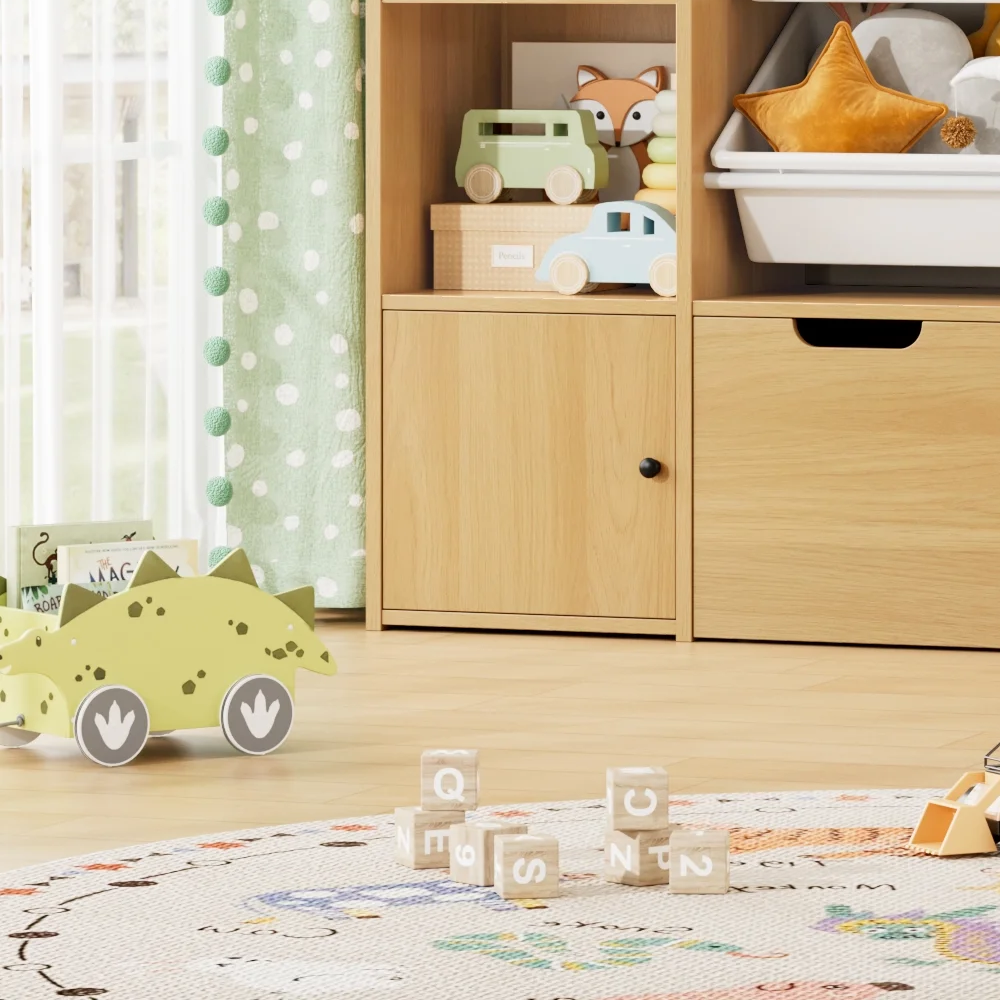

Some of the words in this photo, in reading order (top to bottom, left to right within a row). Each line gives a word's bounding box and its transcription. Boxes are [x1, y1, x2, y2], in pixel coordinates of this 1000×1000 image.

[96, 556, 112, 572] THE
[434, 767, 466, 802] Q
[624, 788, 658, 817] C
[512, 857, 546, 885] S
[680, 854, 713, 877] 2
